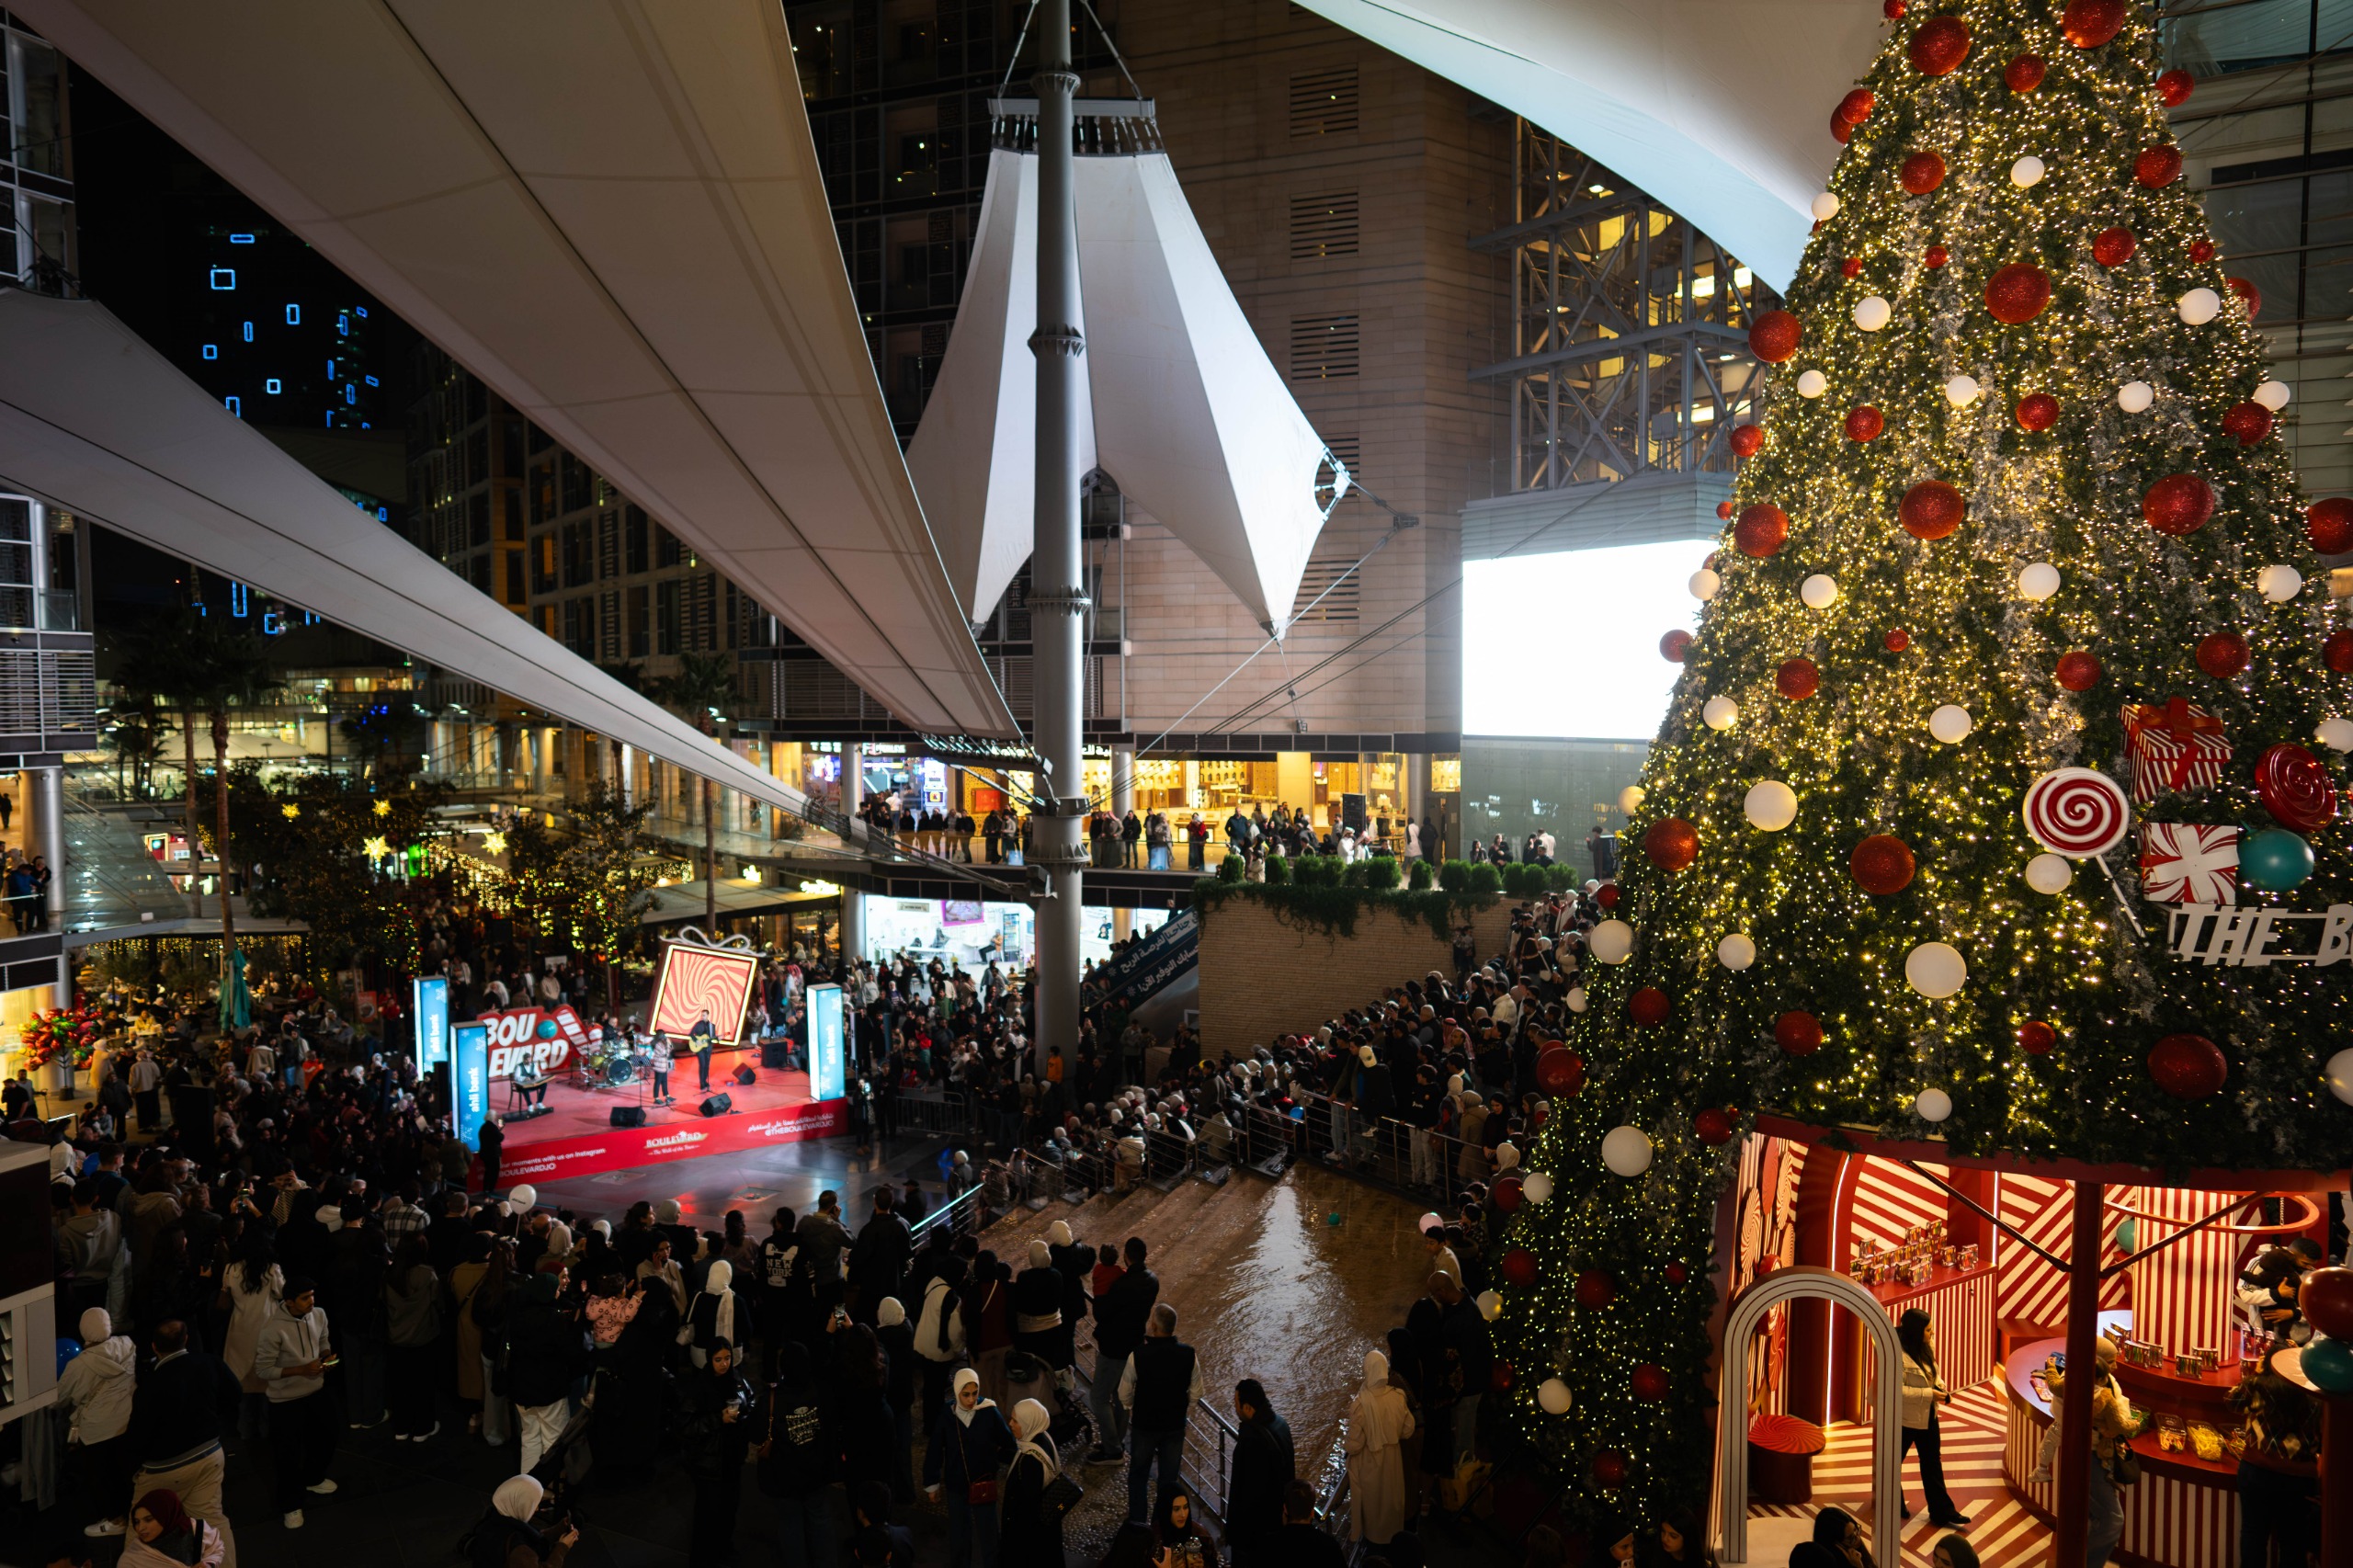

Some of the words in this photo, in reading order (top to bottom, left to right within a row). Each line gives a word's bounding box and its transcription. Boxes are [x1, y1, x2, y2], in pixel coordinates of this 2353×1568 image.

[2177, 903, 2289, 967] THE
[2314, 903, 2353, 967] B
[1120, 952, 1141, 973] الربح
[430, 1014, 439, 1035] bank
[430, 1036, 440, 1052] ahli
[469, 1067, 480, 1092] bank
[469, 1094, 480, 1112] ahli
[646, 1131, 702, 1148] BOULEVARD
[511, 1156, 541, 1167] moments
[542, 1154, 556, 1164] with
[574, 1148, 607, 1159] Instagram
[766, 1258, 792, 1268] NEW
[767, 1267, 793, 1277] YORK
